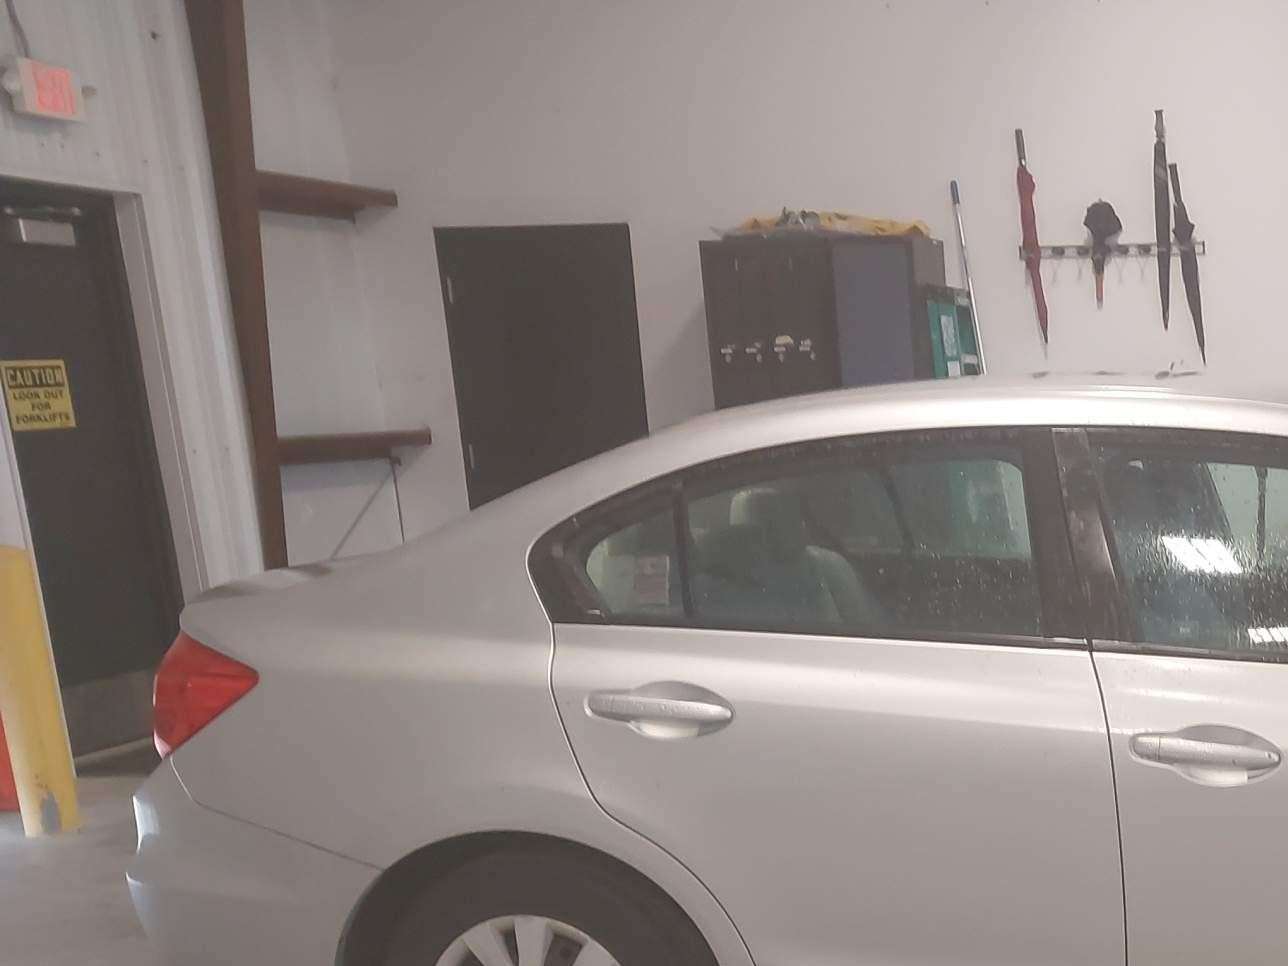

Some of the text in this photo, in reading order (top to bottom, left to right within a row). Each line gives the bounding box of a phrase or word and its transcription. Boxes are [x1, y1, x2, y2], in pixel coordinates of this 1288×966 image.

[7, 367, 63, 386] CAUTION
[13, 389, 64, 401] LOOK OUT
[31, 402, 52, 412] FOR
[15, 412, 70, 424] FORKLIFTS
